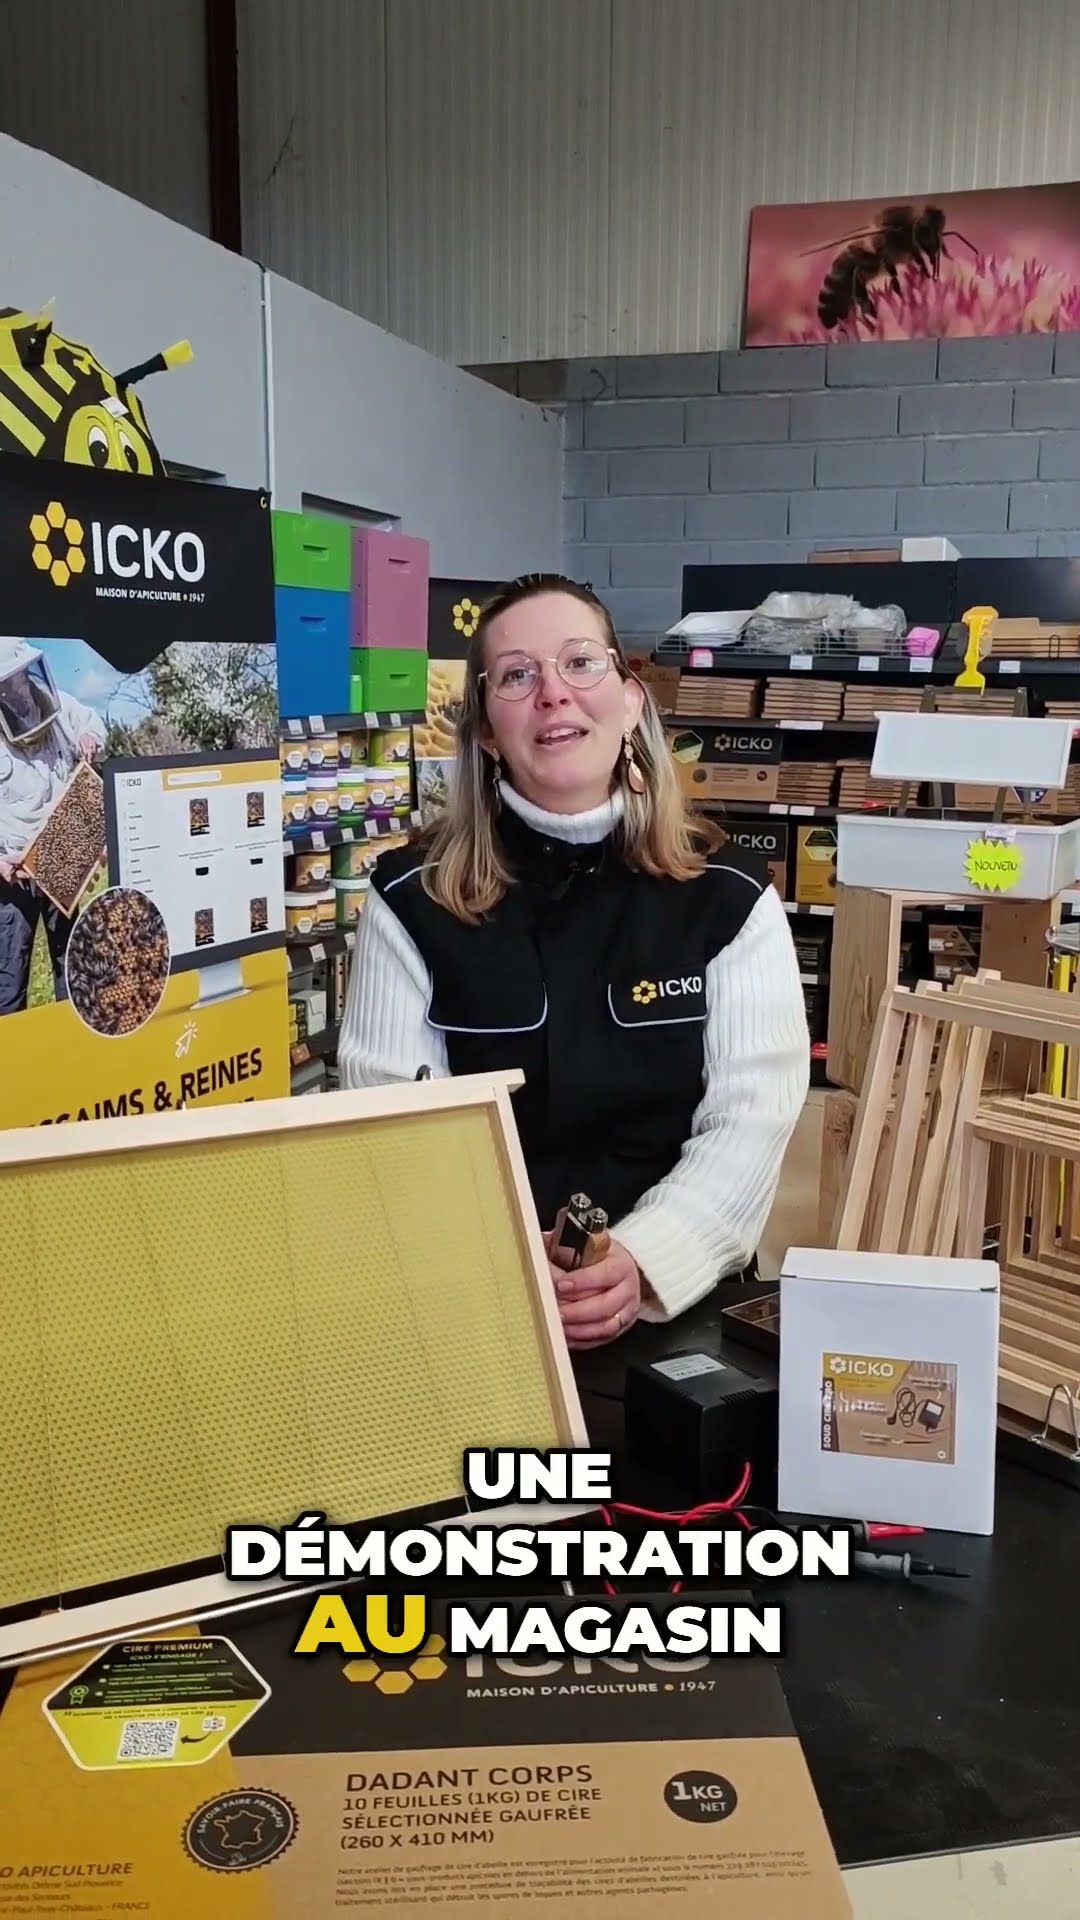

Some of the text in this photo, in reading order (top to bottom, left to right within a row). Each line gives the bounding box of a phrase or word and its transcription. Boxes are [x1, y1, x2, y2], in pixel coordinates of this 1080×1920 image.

[91, 521, 205, 583] ICKO
[95, 587, 206, 603] MAISON D'APICULTURE 1947
[732, 736, 773, 750] ICKO
[126, 778, 142, 787] ICKO
[658, 976, 702, 997] ICKO
[154, 1080, 172, 1112] &
[181, 1047, 262, 1102] REINES
[848, 1360, 894, 1377] ICKO
[822, 1423, 832, 1449] SOUD
[122, 1642, 213, 1653] CIRE PREMIUM
[466, 1680, 716, 1698] MAISON D'APICULTURE 1947
[346, 1765, 592, 1792] DADANT CORPS
[343, 1788, 602, 1810] 10 FEUILLES (1KG) DE CIRE
[671, 1781, 723, 1800] 1KG
[700, 1802, 726, 1812] NET
[342, 1804, 591, 1830] SÉLECTIONNÉE GAUFRÉE
[340, 1829, 494, 1850] (260 X 410 MM)
[17, 1862, 134, 1878] APICULTURE
